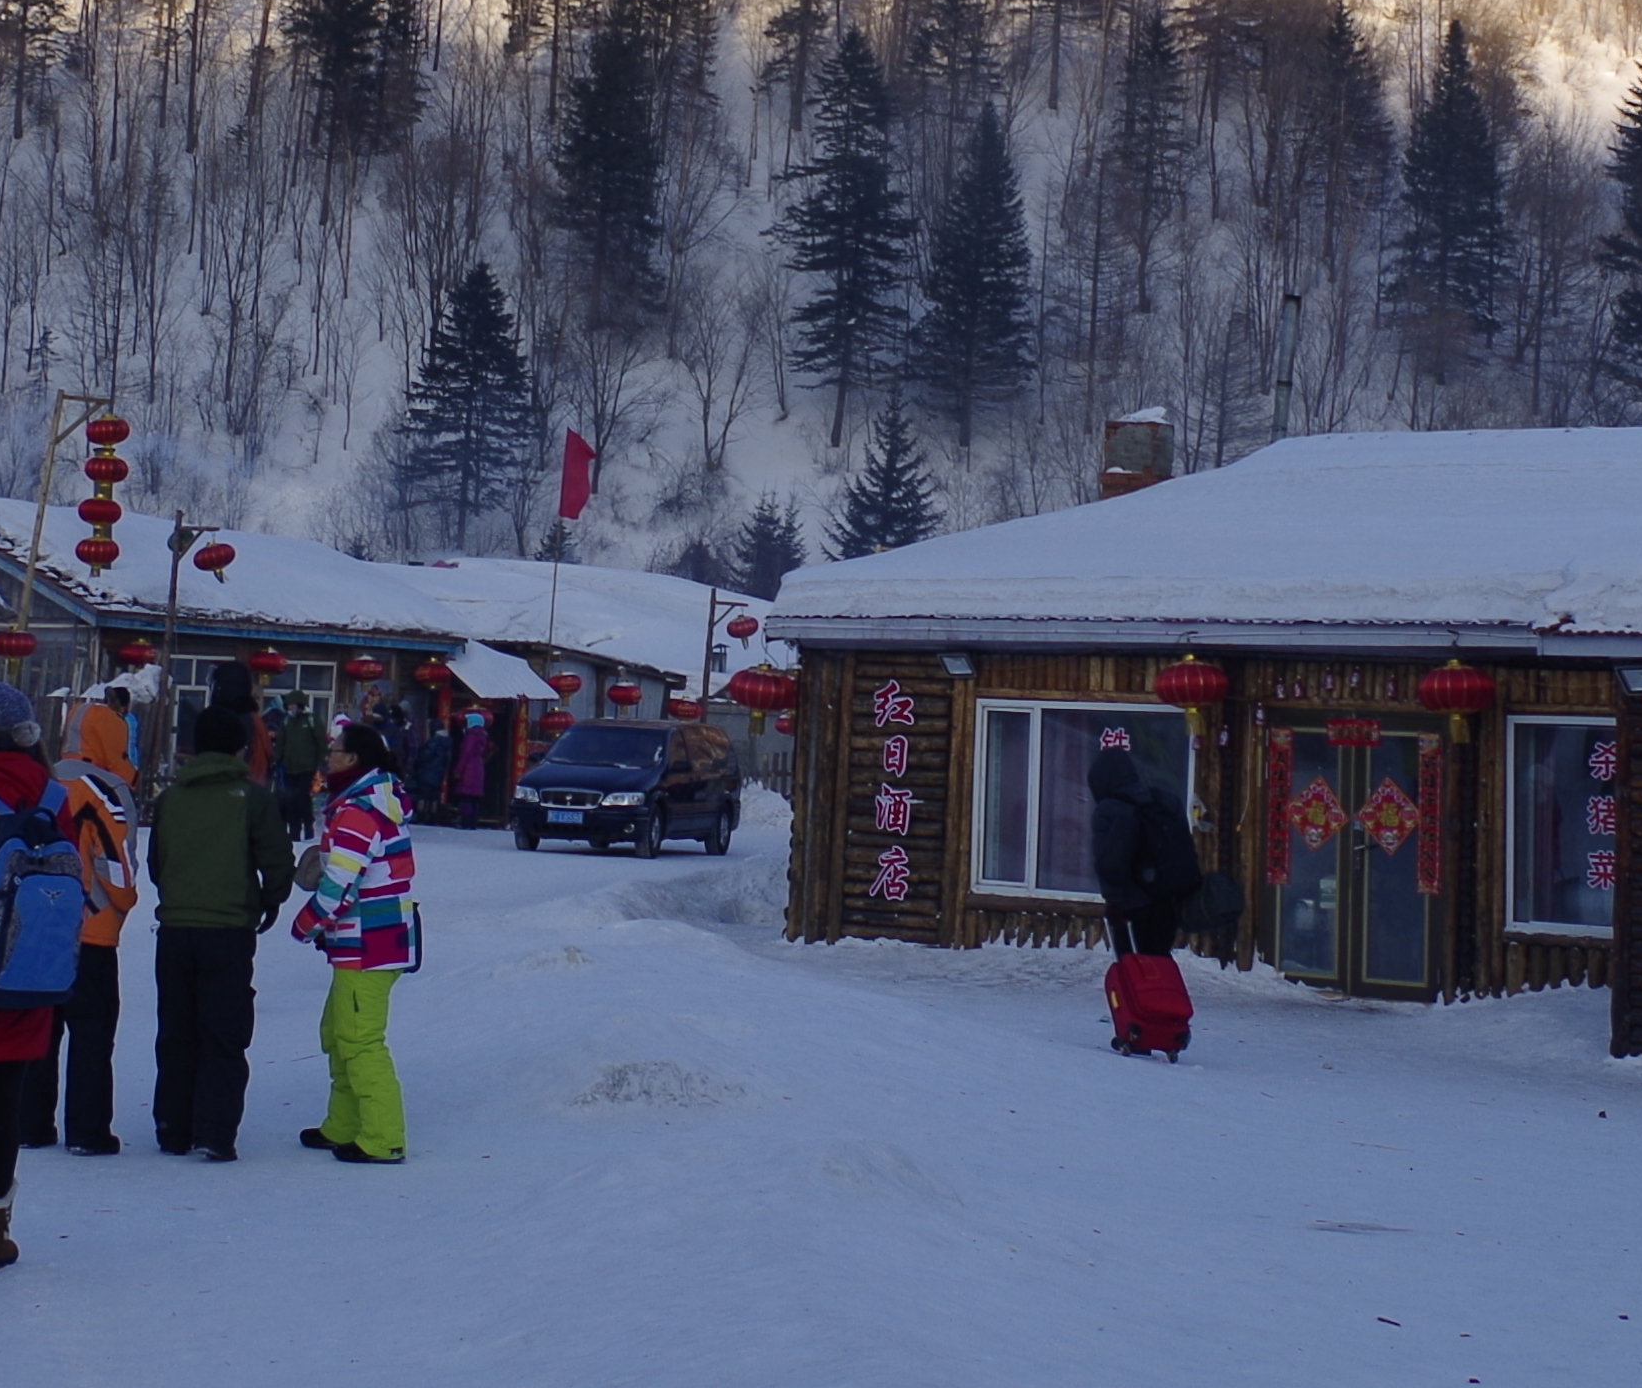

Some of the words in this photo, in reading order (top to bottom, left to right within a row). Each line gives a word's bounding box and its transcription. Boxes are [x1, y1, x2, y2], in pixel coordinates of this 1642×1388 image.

[869, 679, 914, 900] 红日酒店
[1587, 741, 1617, 890] 杀猪菜
